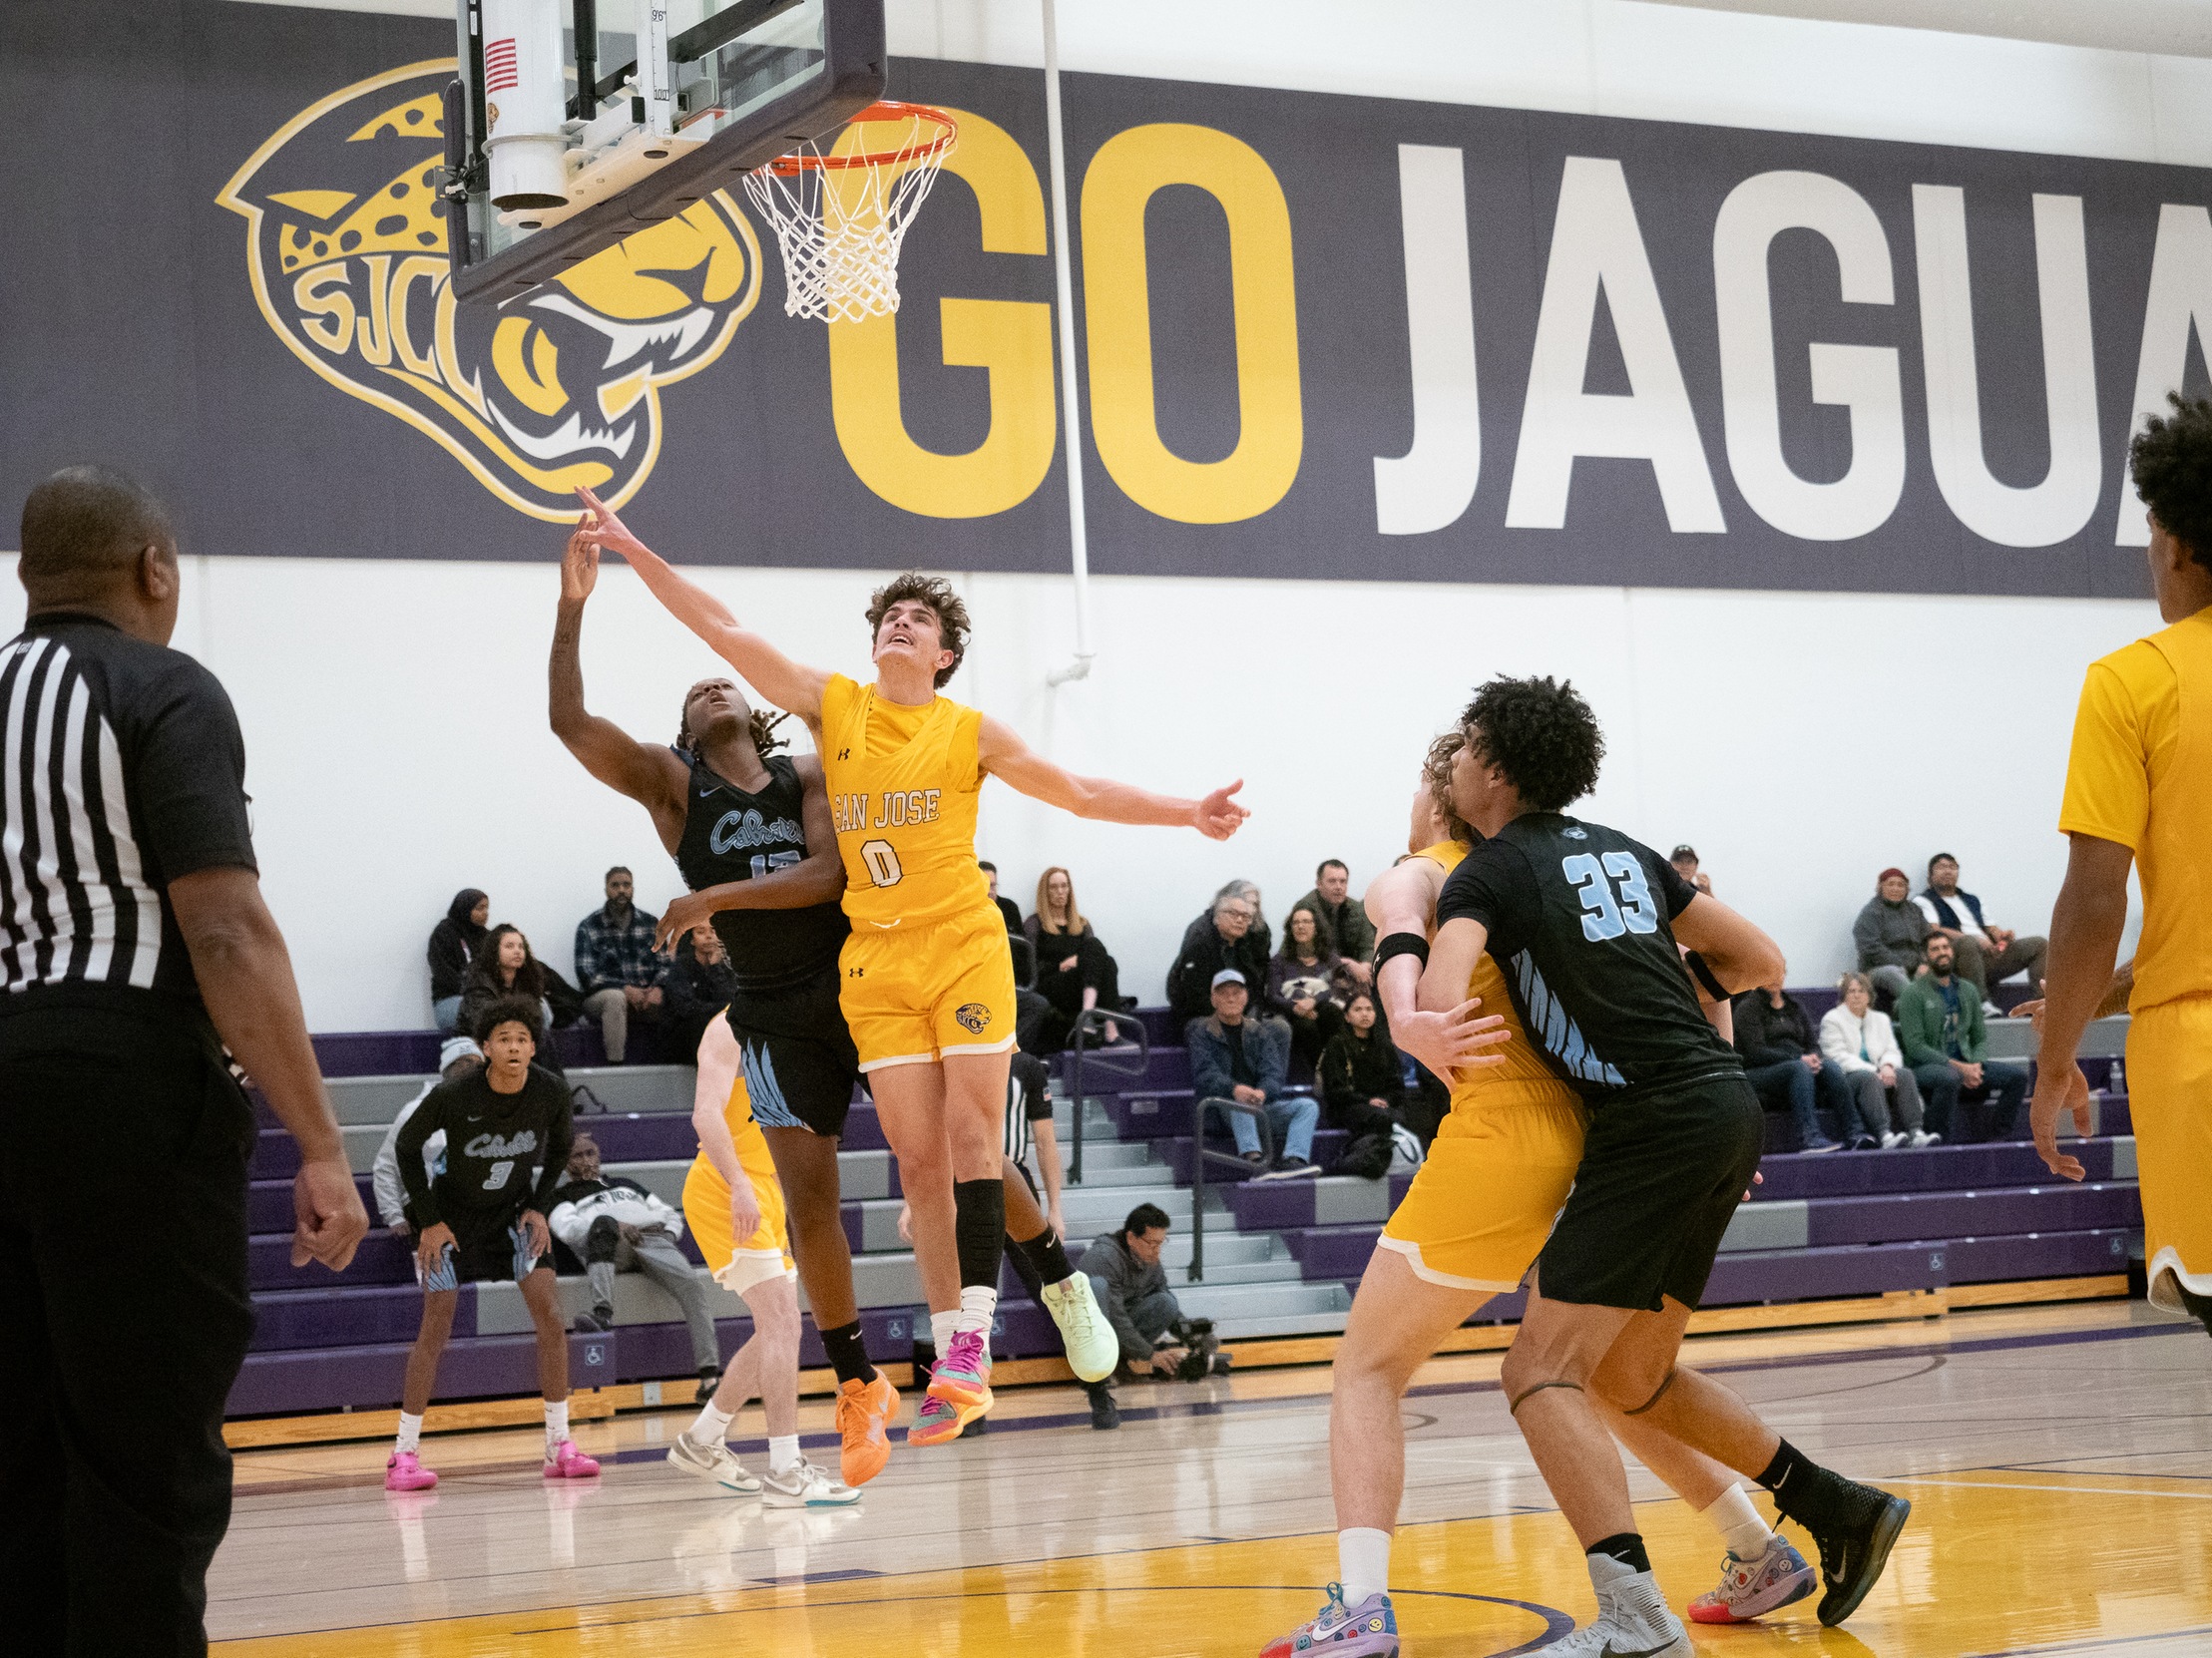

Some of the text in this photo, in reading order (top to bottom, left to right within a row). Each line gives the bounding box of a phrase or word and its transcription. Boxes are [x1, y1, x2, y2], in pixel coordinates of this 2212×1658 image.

[823, 103, 1303, 525] GO
[874, 788, 941, 828] JOSE
[860, 839, 904, 888] 0
[1561, 851, 1658, 943] 33
[482, 1160, 515, 1190] 3
